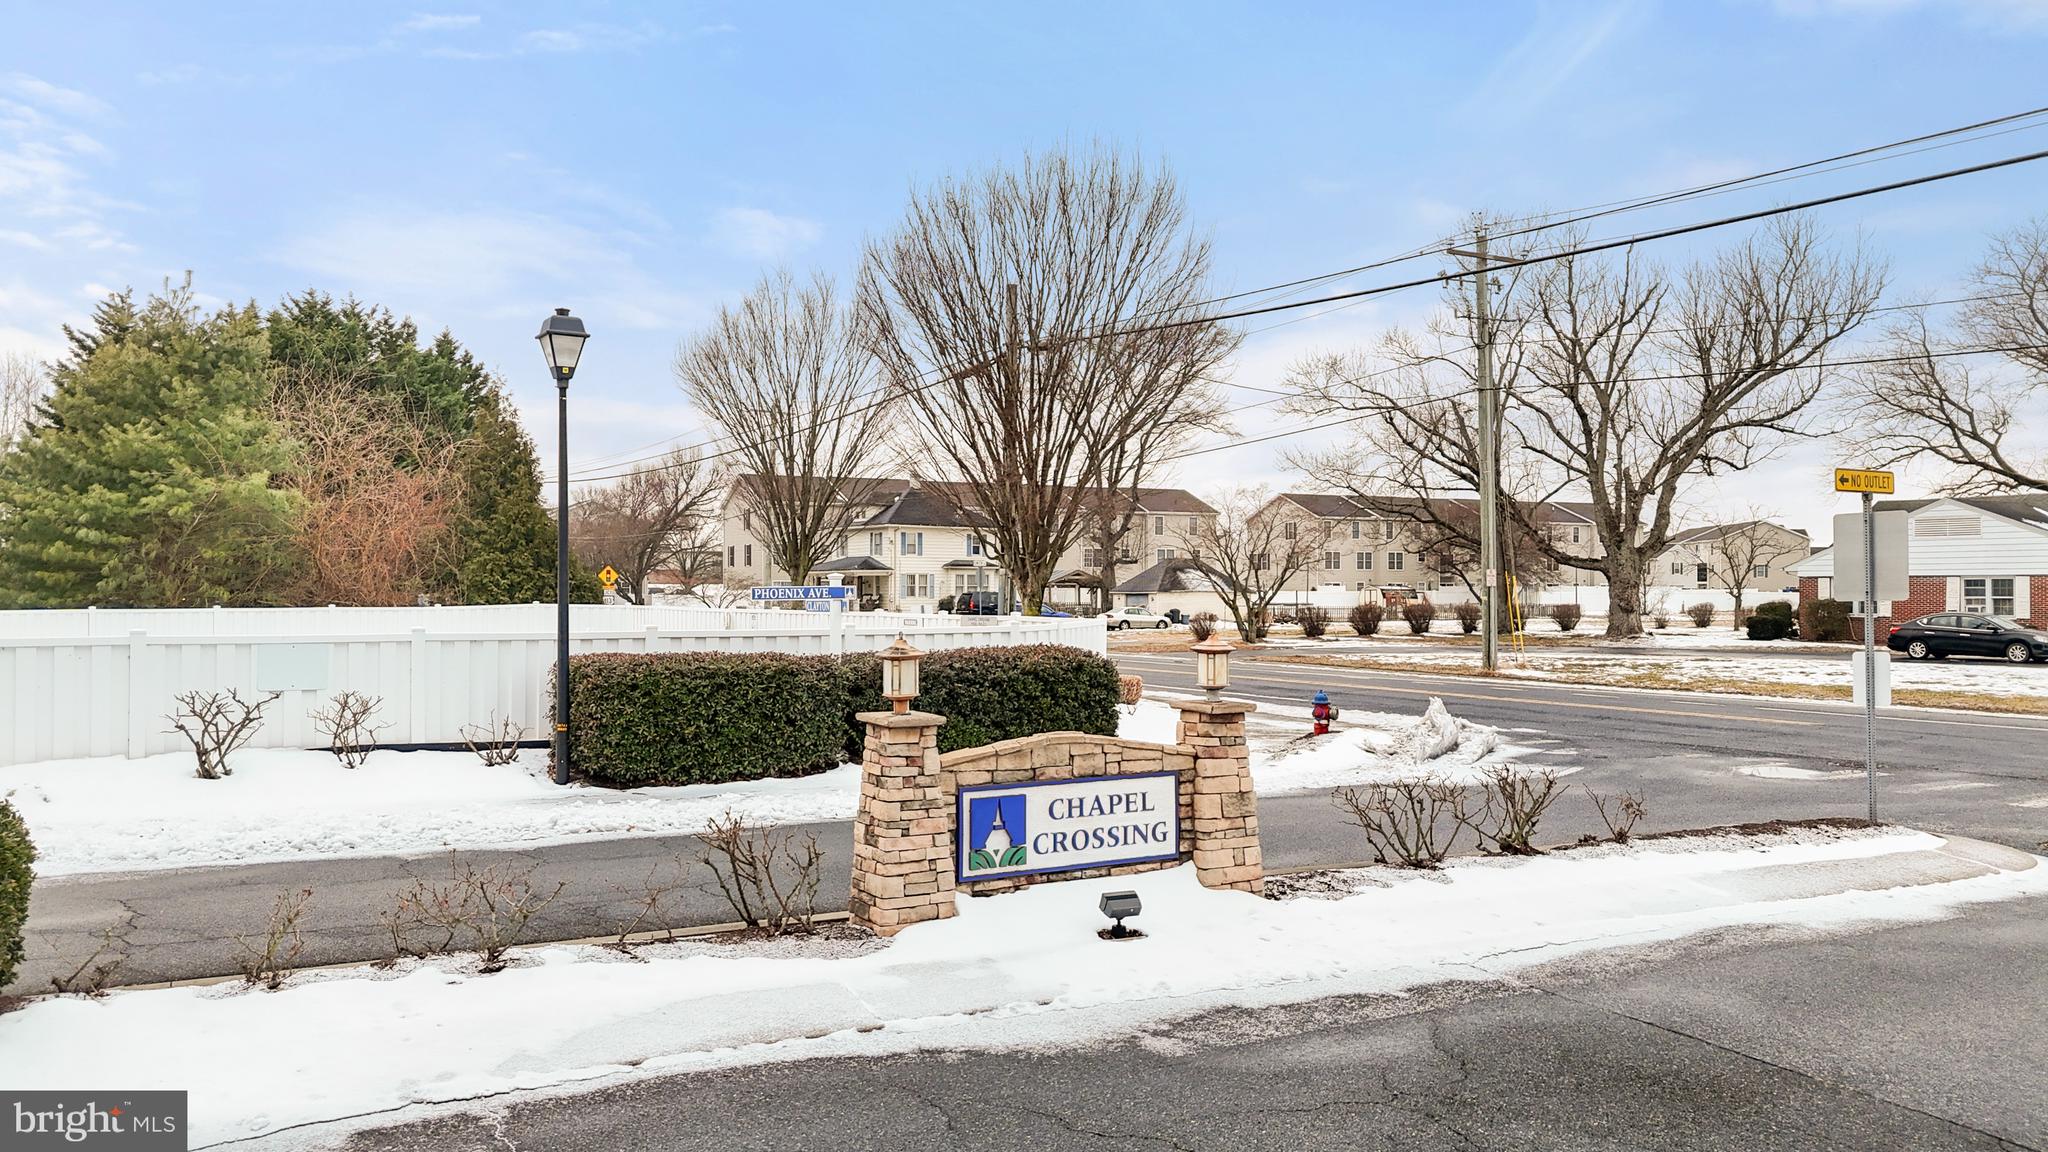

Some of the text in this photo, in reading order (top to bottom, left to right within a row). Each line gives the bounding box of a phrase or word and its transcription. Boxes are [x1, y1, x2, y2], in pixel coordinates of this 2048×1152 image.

[1851, 474, 1890, 489] NO OUTLET
[754, 588, 832, 599] PHOENIX AVE.
[807, 601, 830, 611] CLAYTON
[1048, 791, 1155, 821] CHAPEL
[1033, 821, 1169, 855] CROSSING
